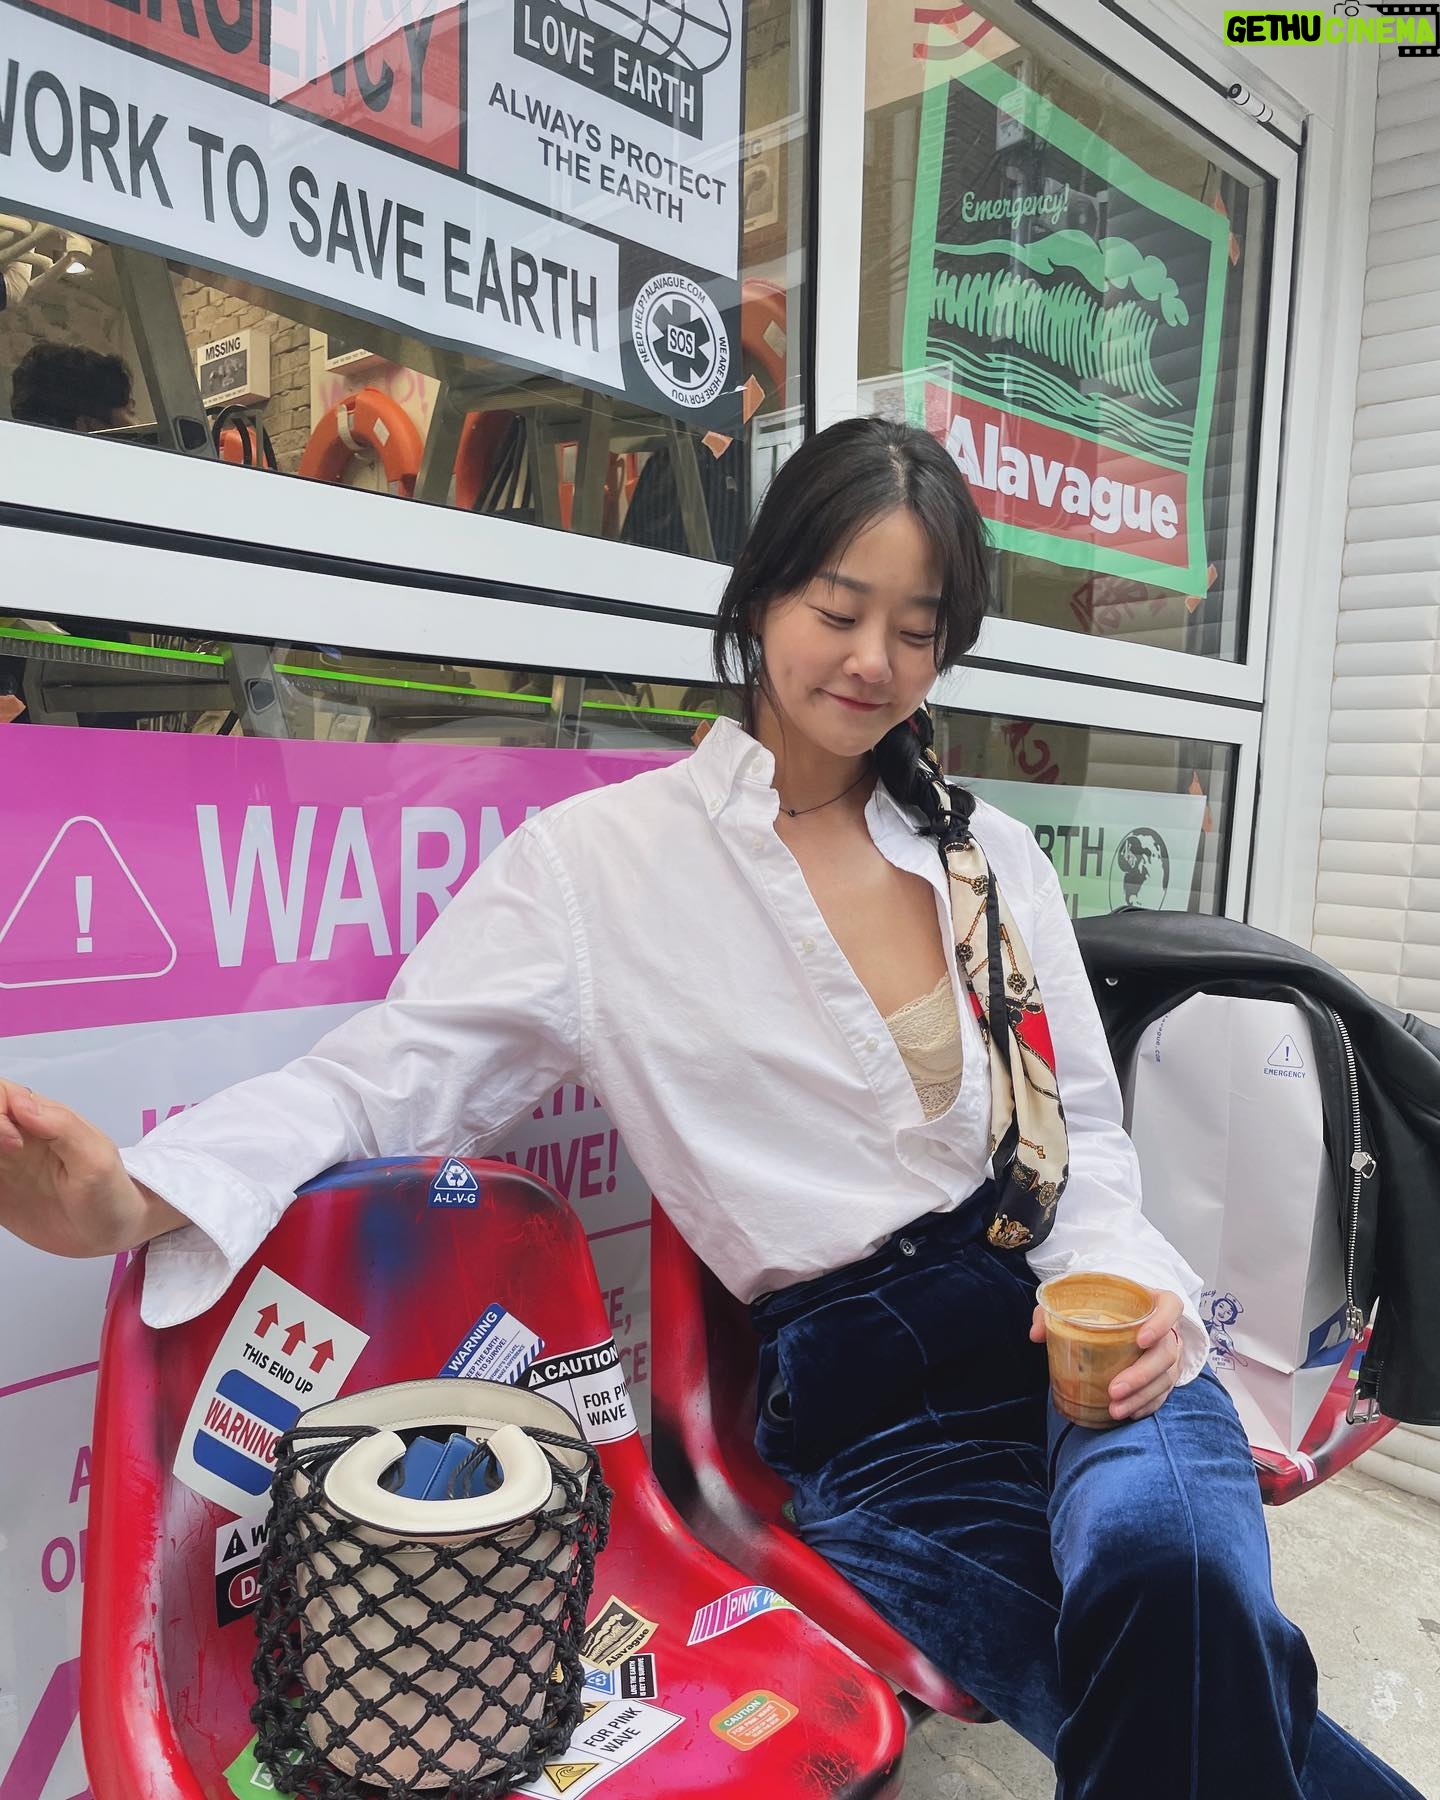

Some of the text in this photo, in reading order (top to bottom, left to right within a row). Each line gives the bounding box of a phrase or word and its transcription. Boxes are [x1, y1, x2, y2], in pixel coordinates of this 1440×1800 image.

[523, 4, 696, 124] LOVE EARTH
[488, 81, 727, 206] ALWAYS PROTECT
[537, 136, 684, 224] THE EARTH
[961, 182, 1070, 230] Emergency!
[187, 125, 270, 239] TO
[288, 165, 426, 297] SAVE
[443, 220, 600, 353] EARTH
[634, 276, 706, 363] NEED HELP? ALAVAGUE.COM
[205, 336, 241, 361] MISSING
[669, 327, 693, 356] SOS
[671, 336, 728, 405] WE ARE HERE FOR YOU
[943, 414, 1179, 540] Alavague
[195, 804, 540, 968] WAR
[1263, 1067, 1306, 1079] EMERGENCY
[433, 1192, 476, 1204] A-L-V-G
[448, 1311, 498, 1372] WARNING
[482, 1335, 500, 1355] EARTH
[485, 1337, 507, 1364] SURVIVE!
[242, 1342, 314, 1394] THIS END UP
[544, 1344, 619, 1380] CAUTION
[582, 1390, 612, 1409] FOR
[586, 1403, 628, 1427] WAVE
[729, 1589, 763, 1622] PINK
[604, 1626, 650, 1668] Alavague
[628, 1660, 636, 1675] EARTH
[583, 1727, 614, 1747] FOR
[607, 1706, 643, 1730] PINK
[723, 1699, 762, 1727] CAUTION
[600, 1727, 641, 1753] WAVE
